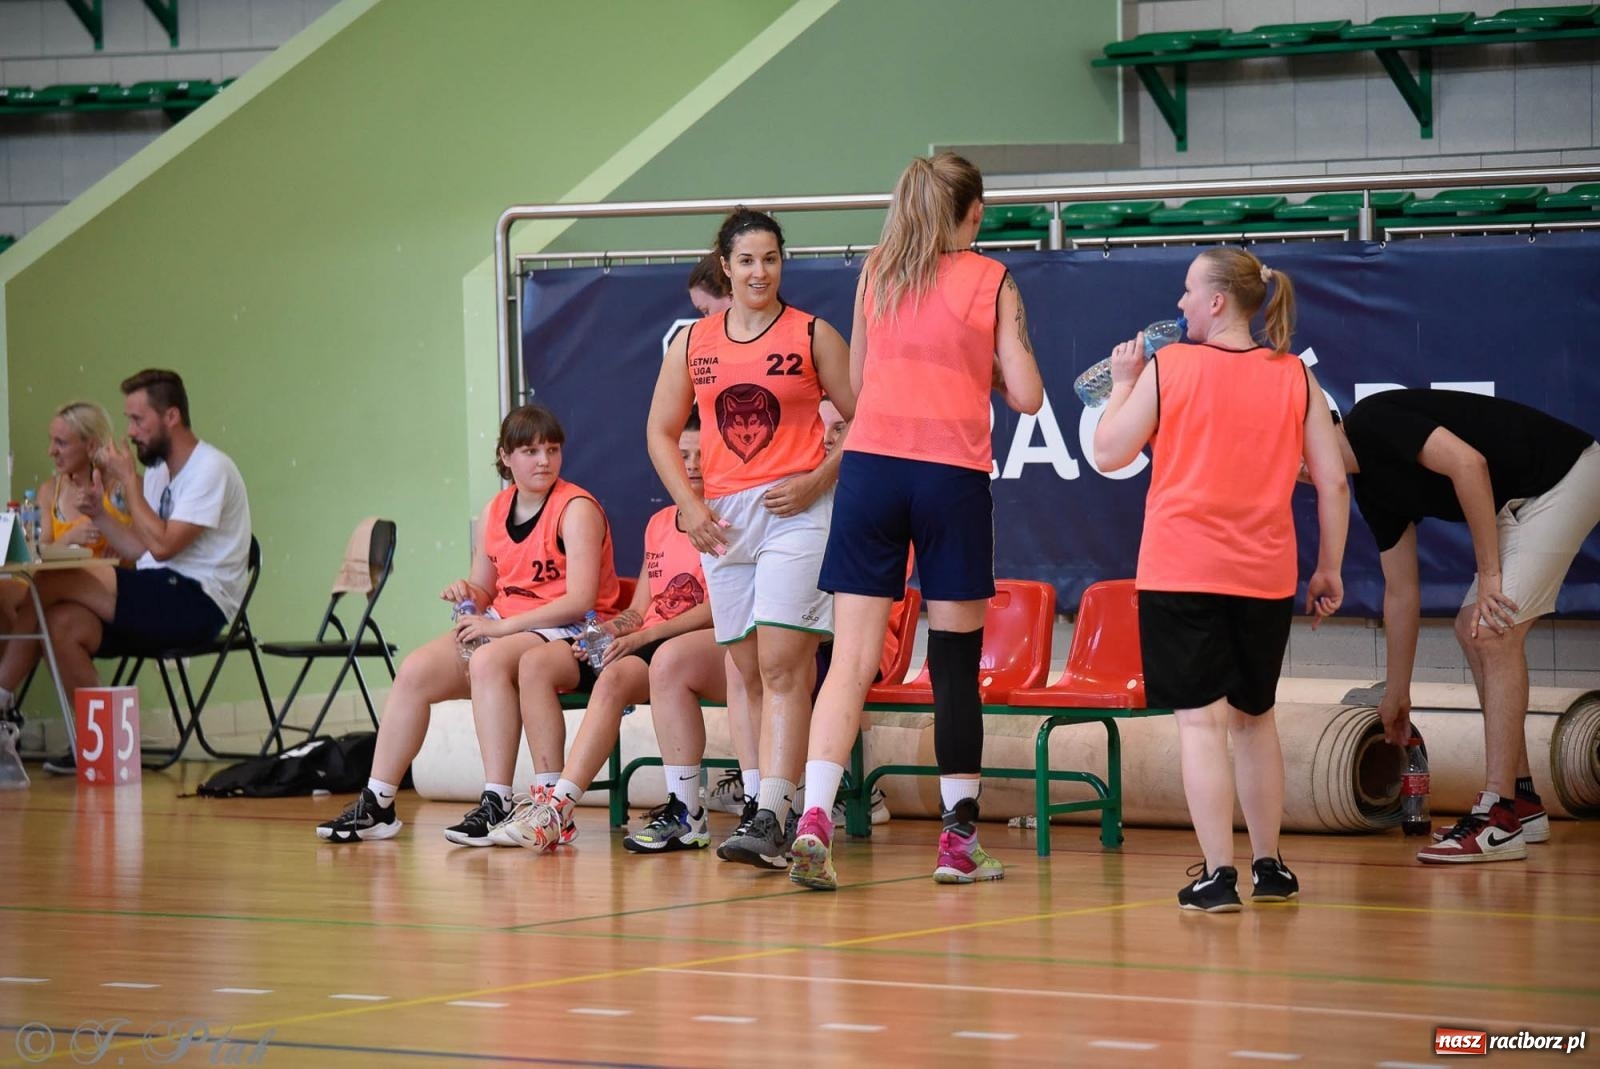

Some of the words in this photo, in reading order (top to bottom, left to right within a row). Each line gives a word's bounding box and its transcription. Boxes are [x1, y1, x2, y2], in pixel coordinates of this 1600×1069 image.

[694, 367, 711, 376] LIGA
[766, 353, 803, 376] 22
[532, 560, 561, 582] 25
[82, 699, 105, 762] 5
[117, 697, 134, 760] 5
